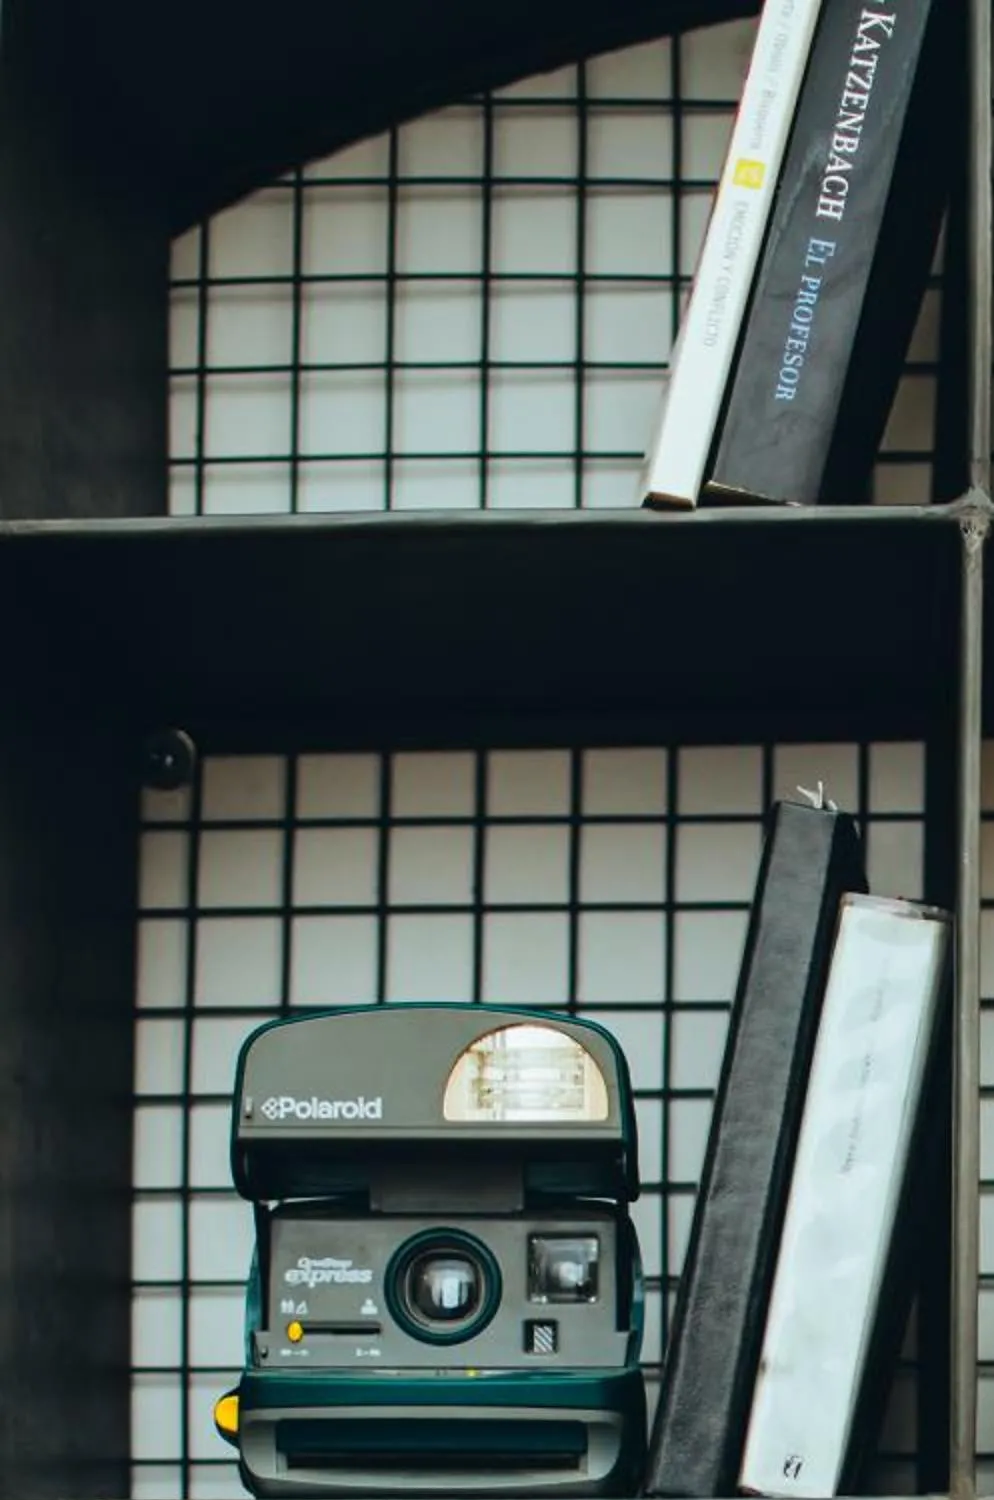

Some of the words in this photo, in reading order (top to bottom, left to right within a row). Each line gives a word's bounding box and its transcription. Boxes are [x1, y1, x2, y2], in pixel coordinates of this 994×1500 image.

[815, 8, 897, 220] KATZENBACH
[774, 276, 822, 401] PROFESOR
[279, 1097, 382, 1120] Polaroid
